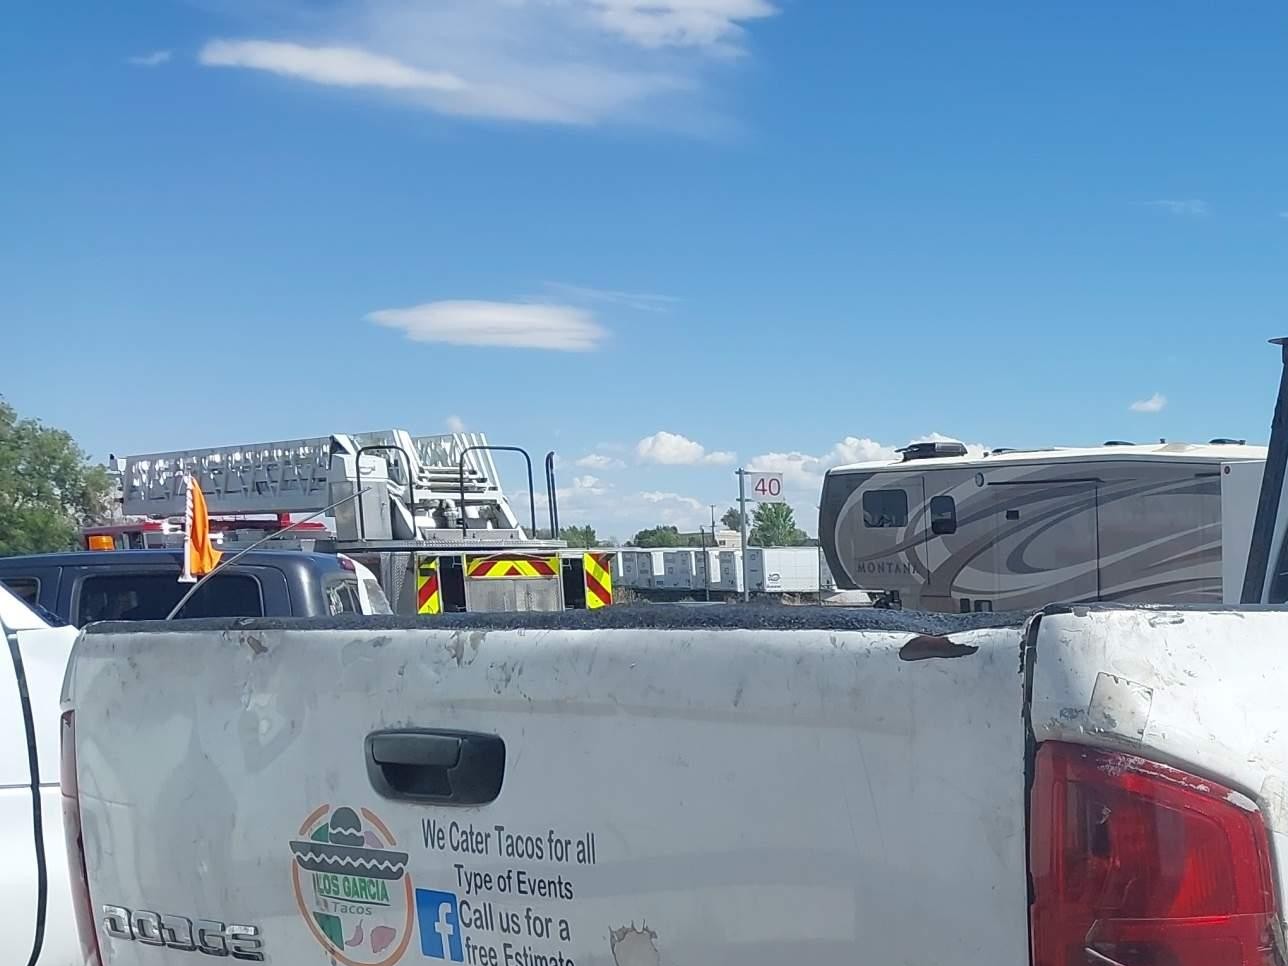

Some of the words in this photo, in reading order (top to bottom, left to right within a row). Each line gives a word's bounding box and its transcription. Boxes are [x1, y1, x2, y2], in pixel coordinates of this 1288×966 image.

[754, 478, 781, 496] 40
[421, 818, 446, 850] We
[449, 820, 491, 856] Cater
[494, 825, 544, 861] Tacos
[548, 830, 571, 863] for
[576, 832, 596, 864] all
[342, 876, 390, 902] GARCIA
[454, 863, 493, 895] Type
[497, 869, 512, 893] of
[517, 870, 573, 900] Events
[331, 901, 373, 916] Tacos
[459, 899, 495, 932] Call
[499, 911, 521, 935] us
[525, 907, 552, 939] for
[558, 918, 571, 942] a
[102, 904, 265, 961] DODGE
